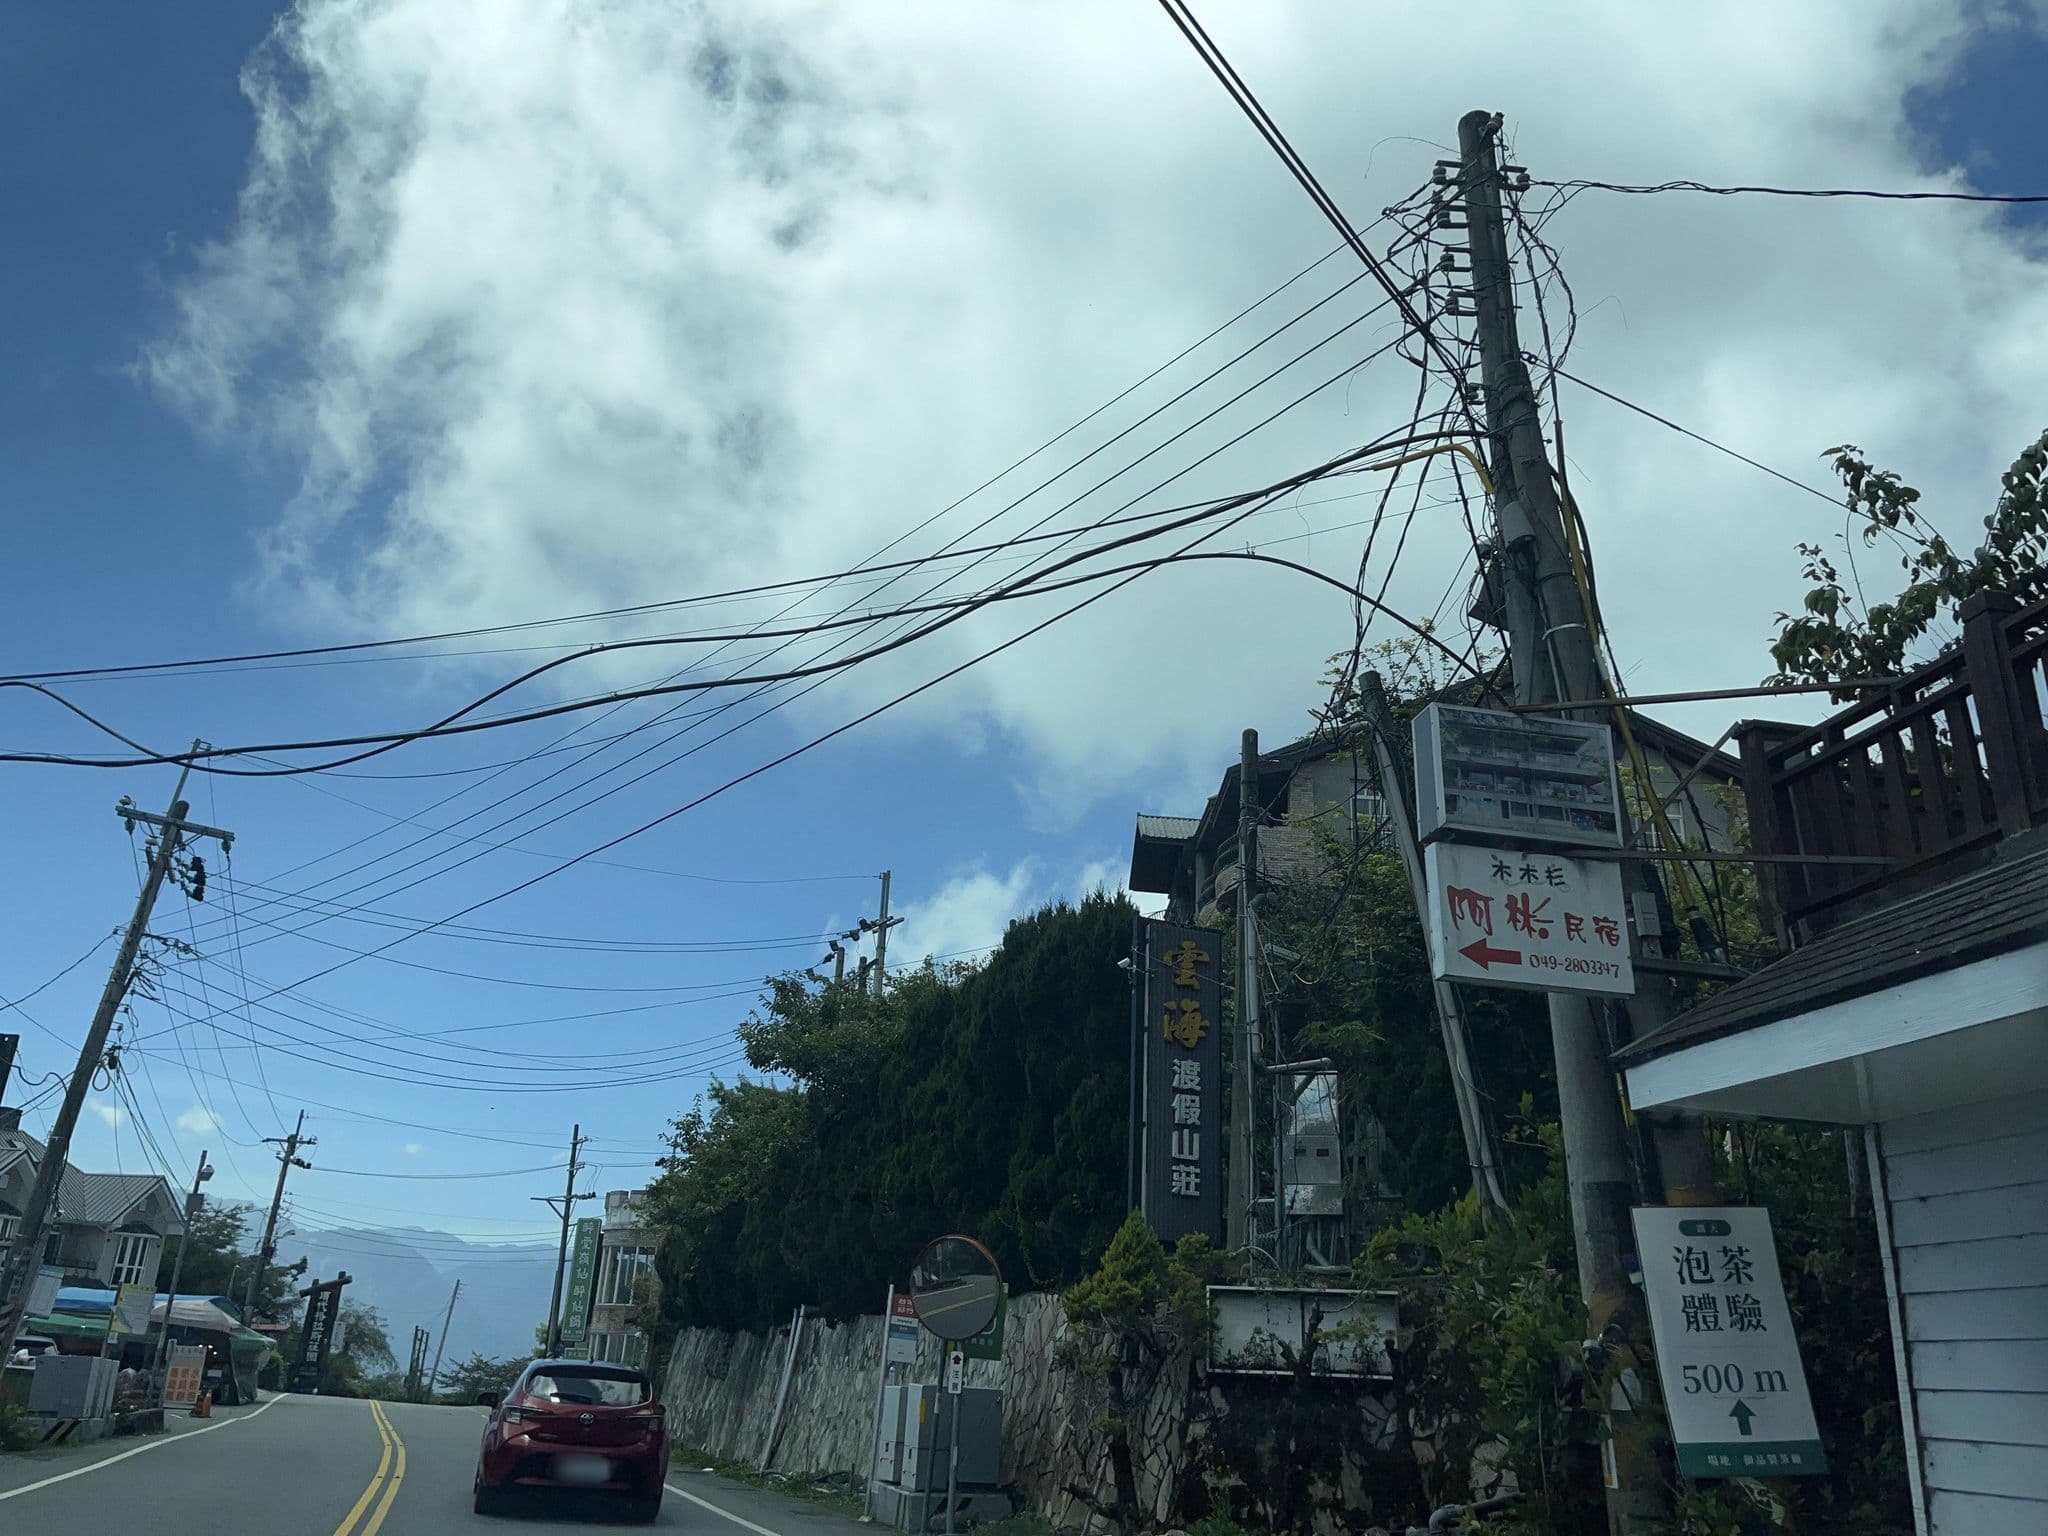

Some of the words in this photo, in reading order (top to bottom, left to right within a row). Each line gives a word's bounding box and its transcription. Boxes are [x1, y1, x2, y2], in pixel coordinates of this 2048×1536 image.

[1529, 953, 1620, 978] 049-2803347
[1171, 1057, 1201, 1197] 渡假山莊
[1672, 1245, 1755, 1285] 泡茶
[1681, 1293, 1767, 1333] 體驗
[1682, 1363, 1744, 1394] 500
[1753, 1369, 1789, 1393] m
